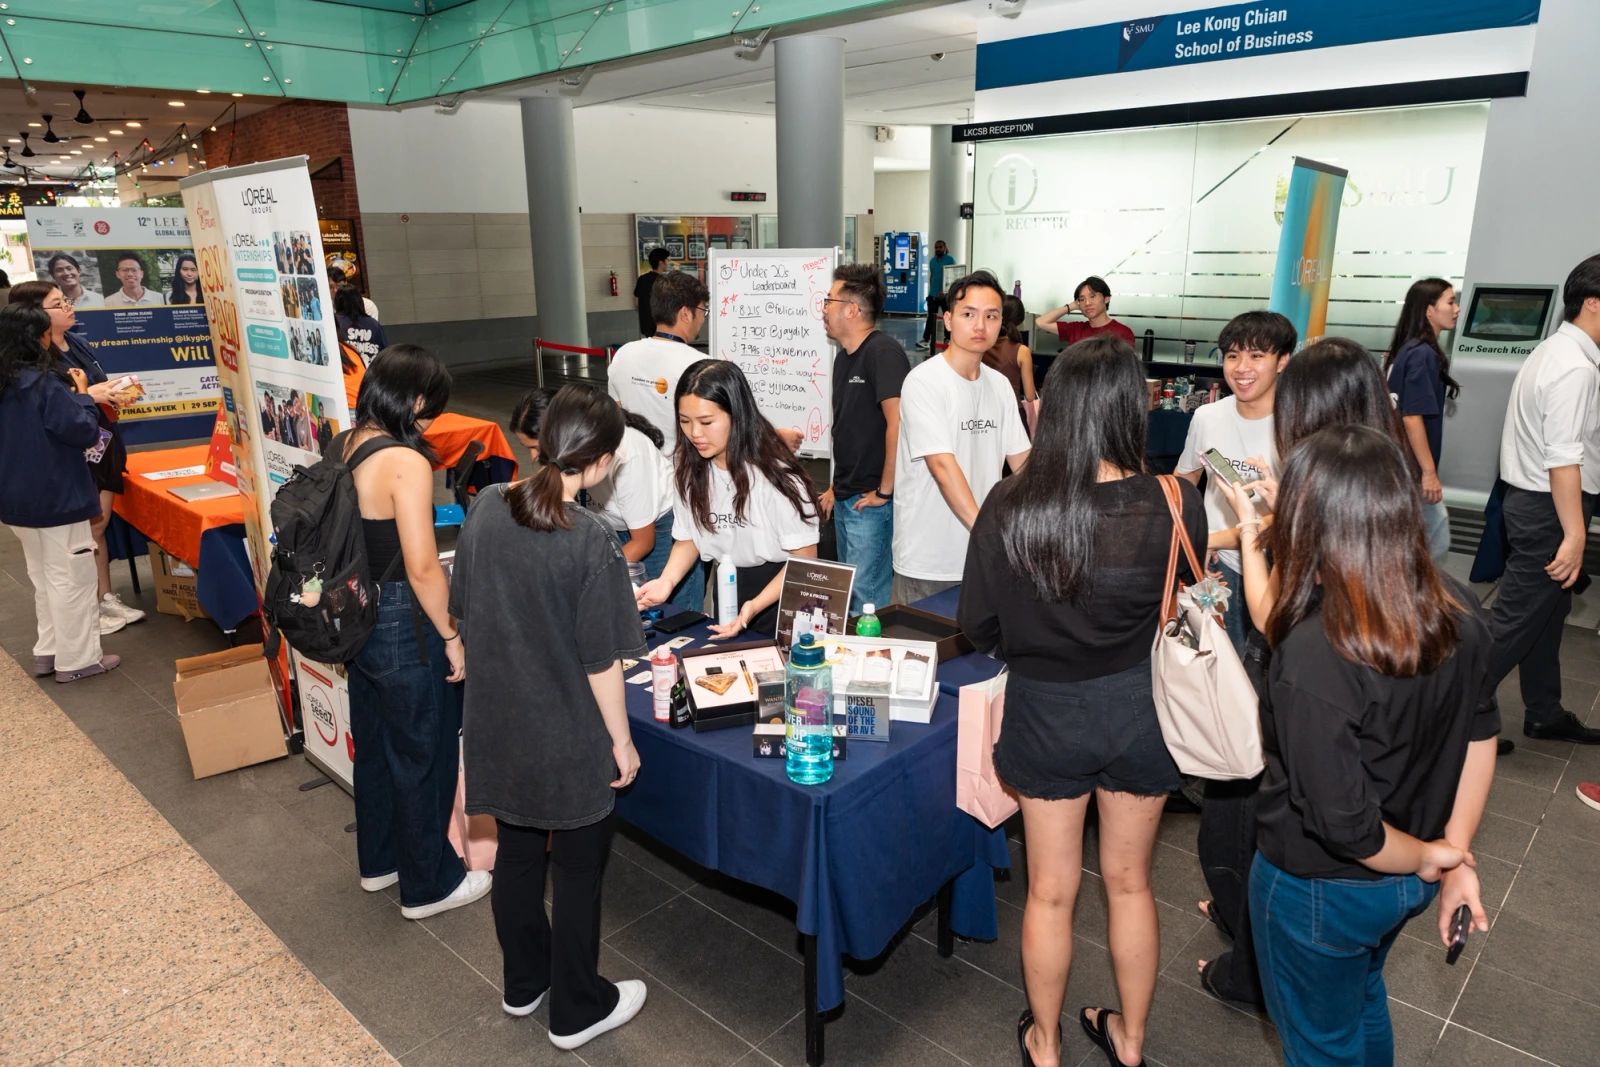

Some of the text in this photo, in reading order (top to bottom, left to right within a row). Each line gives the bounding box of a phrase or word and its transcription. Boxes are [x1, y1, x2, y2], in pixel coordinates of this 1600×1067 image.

[1176, 8, 1287, 36] Lee Kong Chian
[1135, 24, 1155, 34] SMU
[1175, 30, 1313, 59] School of Business
[963, 123, 1034, 137] LKCSB RECEPTION
[241, 186, 278, 206] L'ORÉAL
[154, 218, 179, 227] LEE
[234, 248, 272, 262] INTERNSHIPS
[740, 262, 789, 278] Under 20s
[1291, 255, 1328, 286] L'ORÉAL
[752, 279, 797, 291] Leaderboard
[101, 338, 129, 347] dream
[131, 336, 173, 345] internship
[175, 333, 210, 344] @lkygbp
[347, 327, 372, 341] SMU
[170, 345, 210, 362] Will
[1458, 344, 1535, 355] Car Search Kios
[123, 406, 151, 415] FINALS
[154, 405, 176, 413] WEEK
[961, 419, 997, 431] L'ORÉAL
[847, 695, 875, 707] DIESEL
[848, 706, 876, 716] SOUND
[848, 716, 875, 726] OF THE
[848, 725, 875, 735] BRAVE
